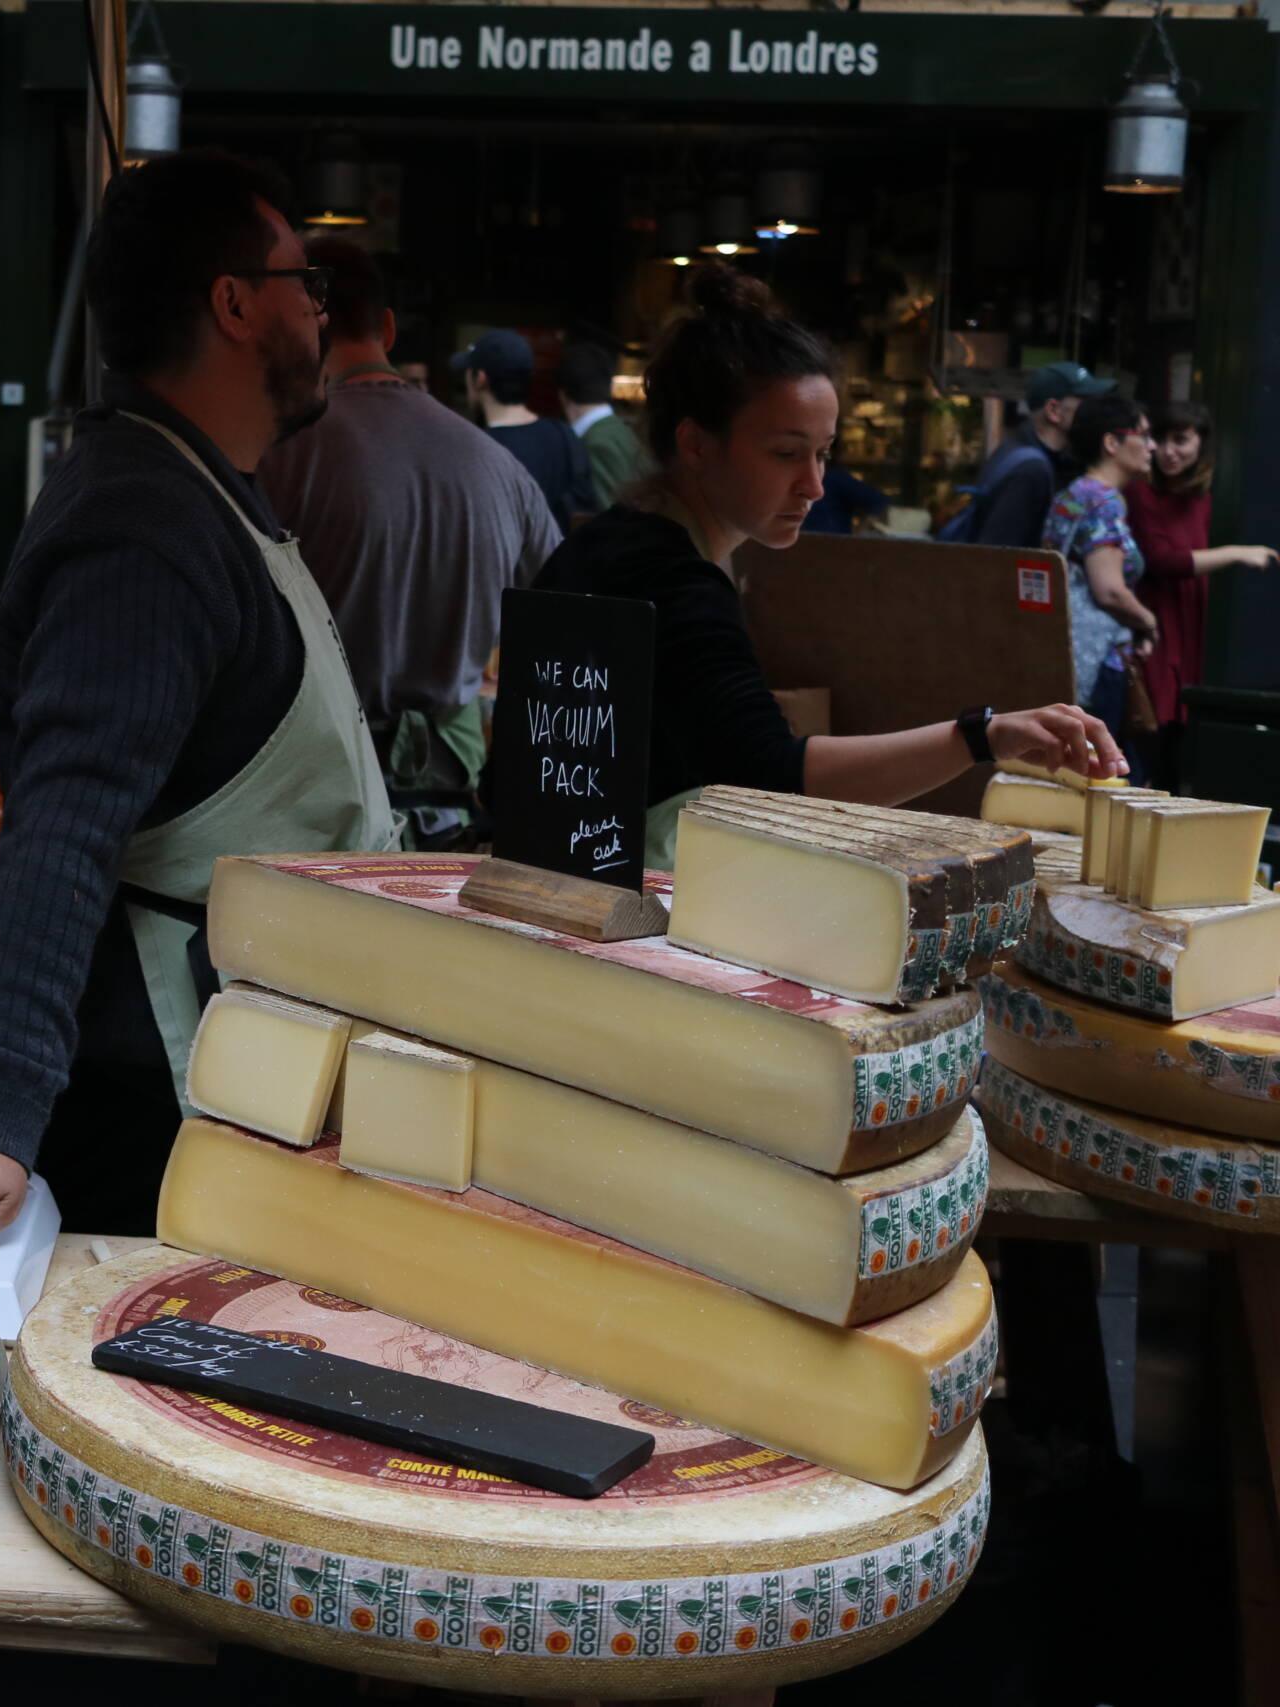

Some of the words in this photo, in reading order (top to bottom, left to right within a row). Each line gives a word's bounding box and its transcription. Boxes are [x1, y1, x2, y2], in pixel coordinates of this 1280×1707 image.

[389, 25, 462, 70] Une
[477, 25, 673, 72] Normande
[688, 40, 712, 72] a
[729, 28, 880, 76] Londres
[535, 660, 562, 686] WE
[572, 665, 608, 692] CAN
[527, 697, 616, 758] VACUUM
[541, 756, 604, 798] PACK
[570, 815, 625, 855] please
[593, 834, 622, 861] ask
[259, 1424, 319, 1447] PETITE
[387, 1458, 453, 1478] COMTÉ
